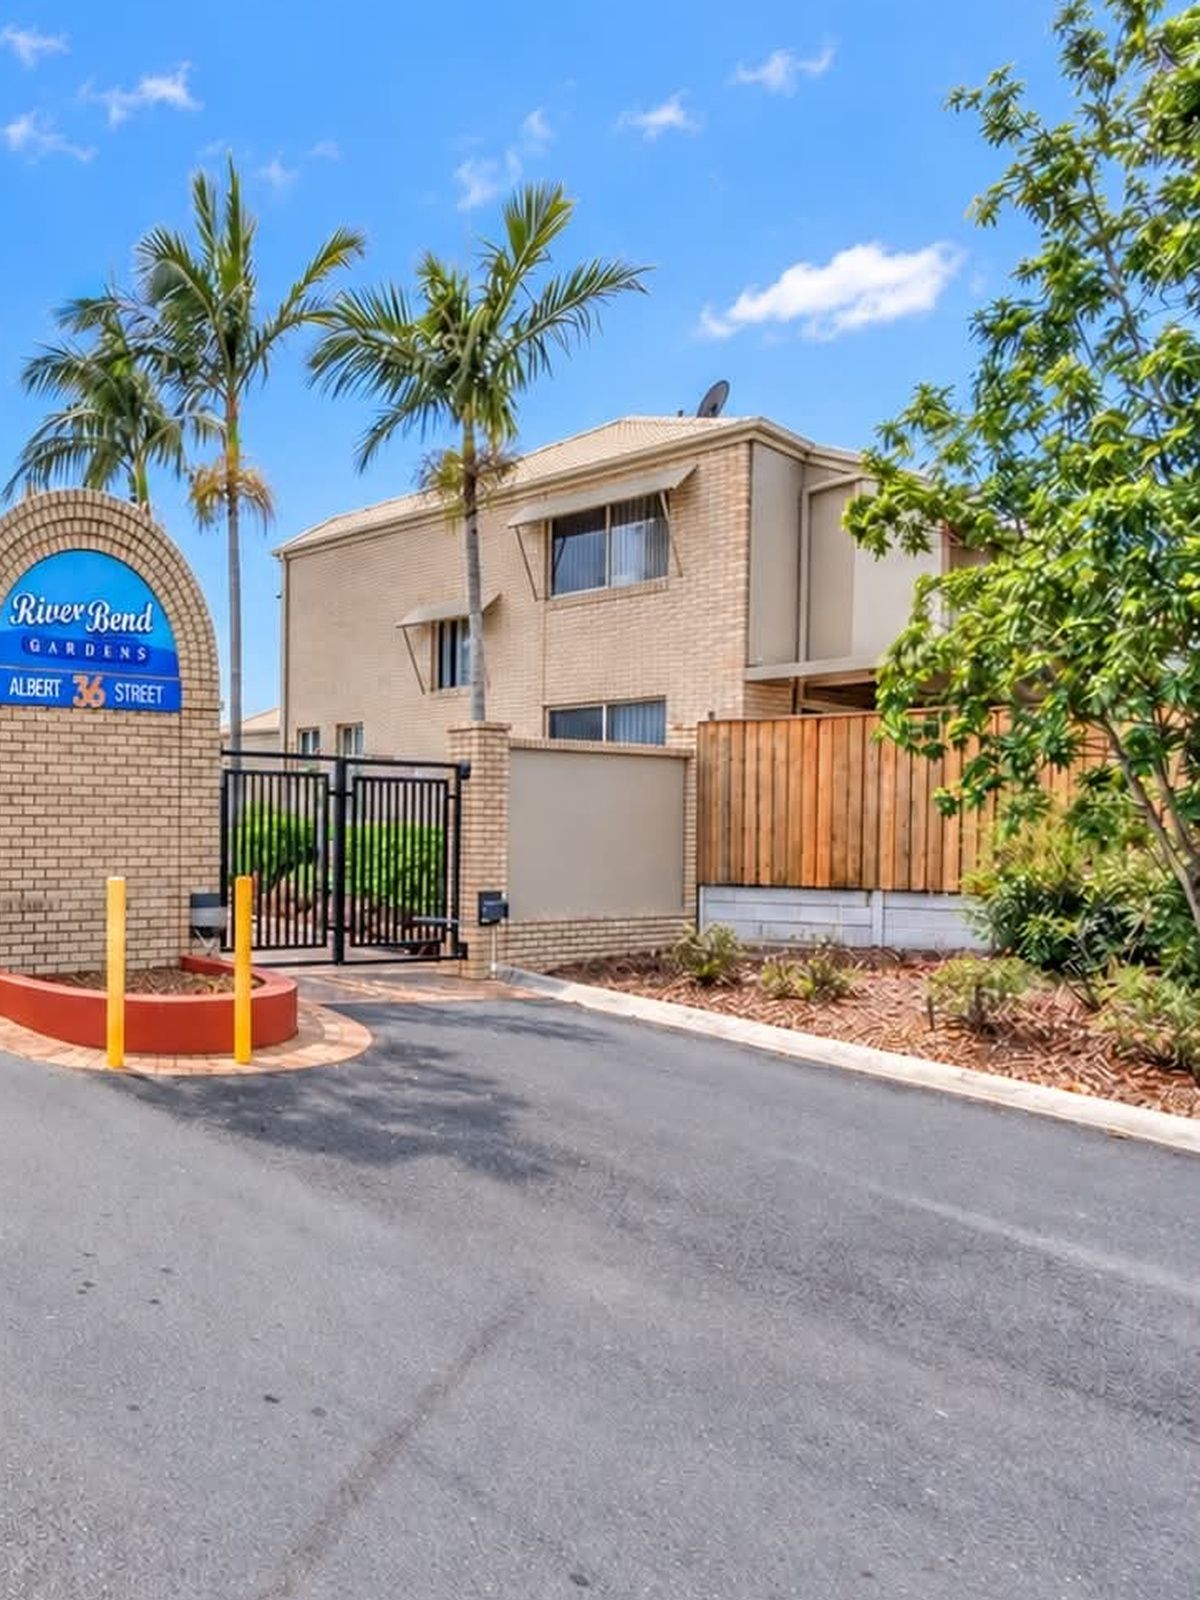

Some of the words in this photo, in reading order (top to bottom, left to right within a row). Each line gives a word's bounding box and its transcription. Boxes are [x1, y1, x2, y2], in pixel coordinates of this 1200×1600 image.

[10, 592, 85, 625] River
[86, 599, 153, 633] Bend
[29, 639, 147, 660] GARDENS
[9, 677, 62, 698] ALBERT
[72, 674, 107, 708] 36
[115, 683, 164, 704] STREET
